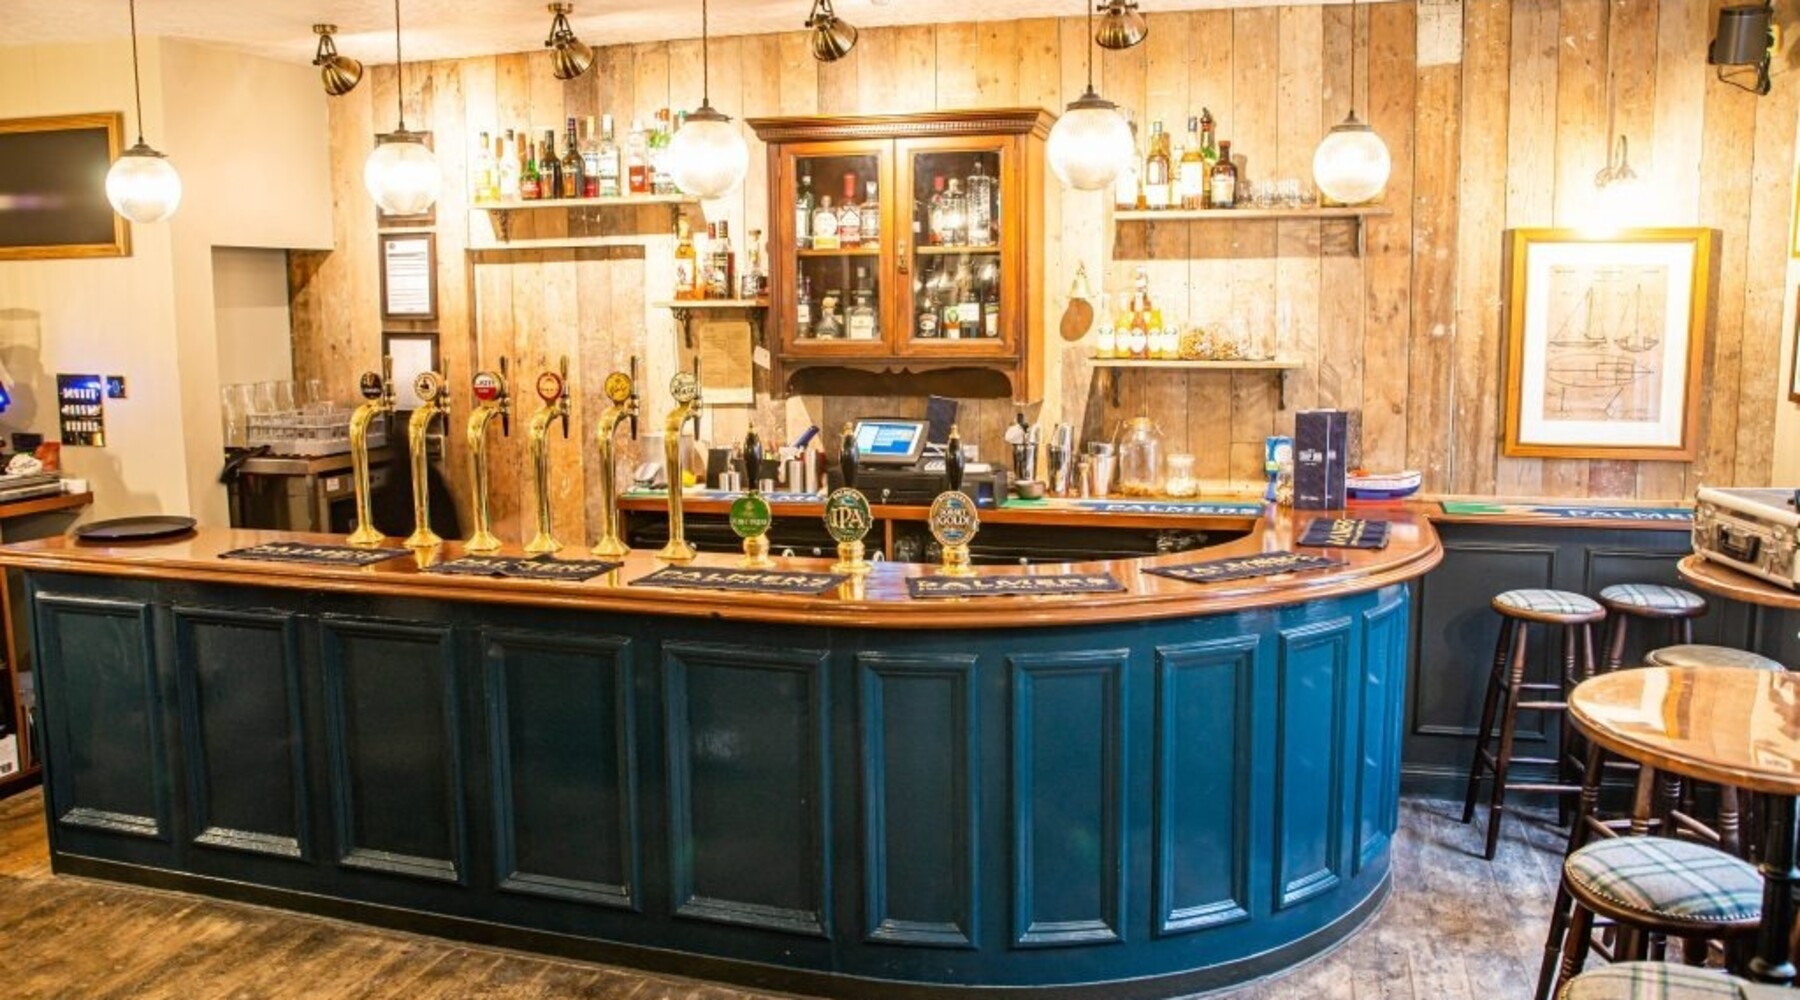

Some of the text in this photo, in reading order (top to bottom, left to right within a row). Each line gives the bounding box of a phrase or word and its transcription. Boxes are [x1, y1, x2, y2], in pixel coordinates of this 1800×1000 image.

[829, 507, 866, 529] IPA
[653, 570, 832, 587] PALMERS
[917, 576, 1109, 591] PALMERS
